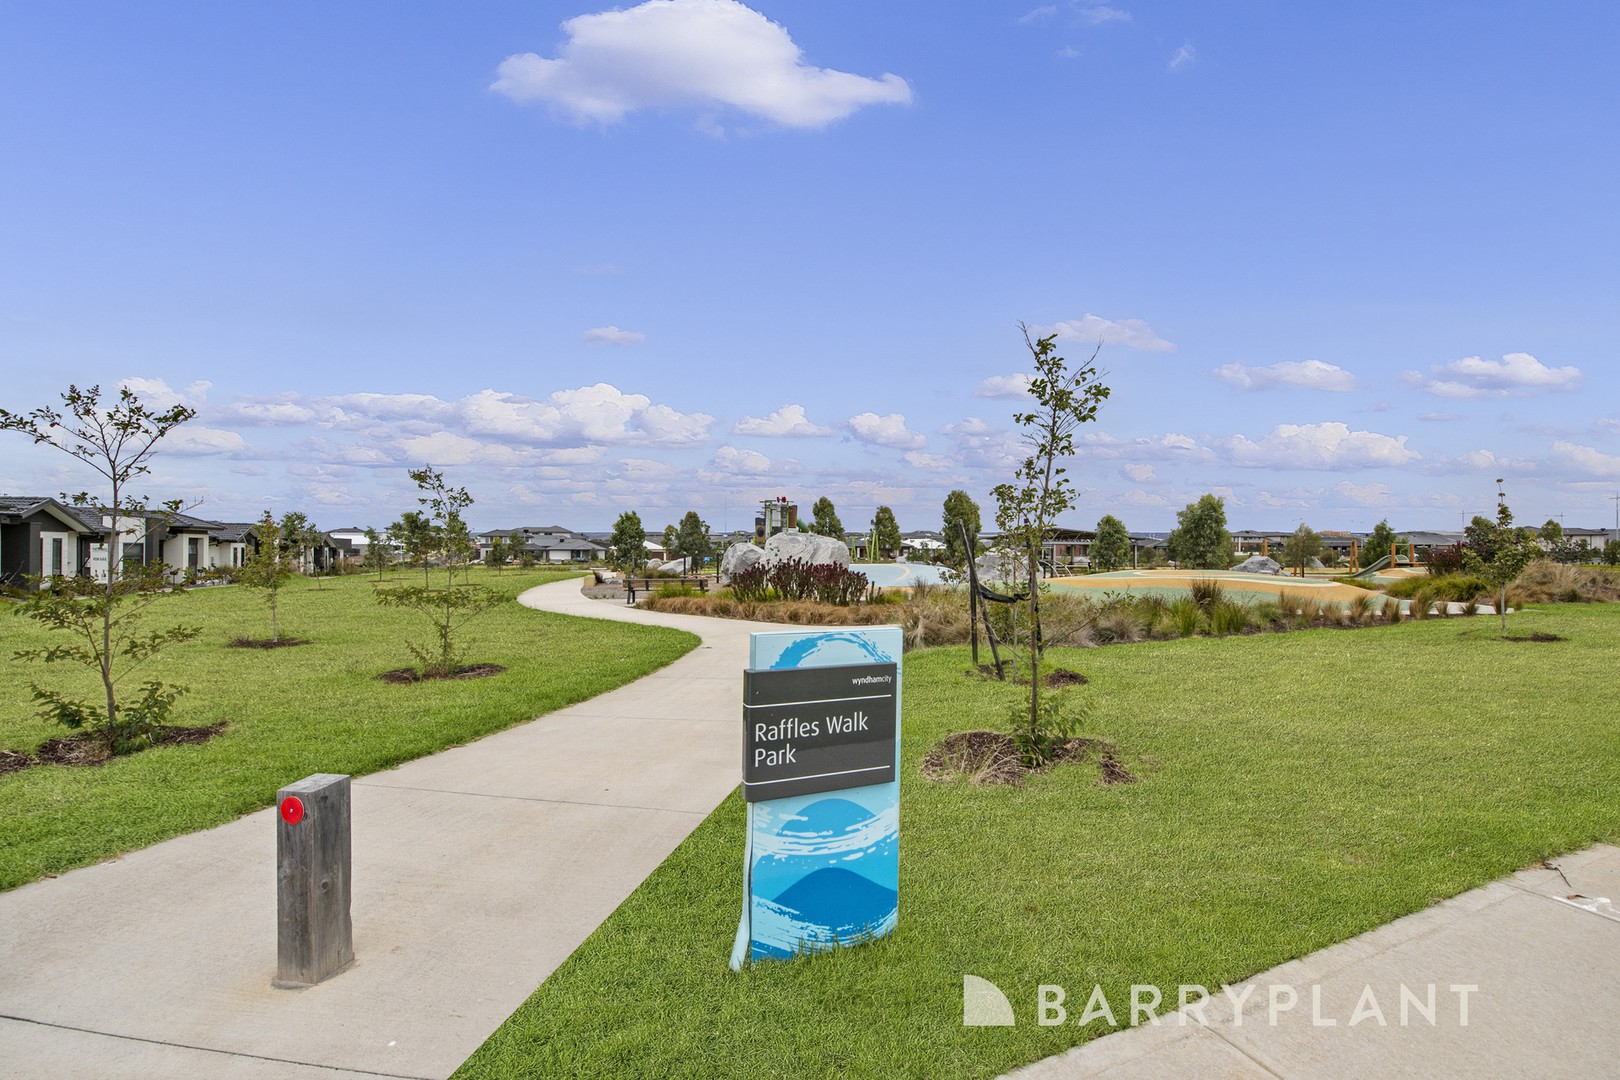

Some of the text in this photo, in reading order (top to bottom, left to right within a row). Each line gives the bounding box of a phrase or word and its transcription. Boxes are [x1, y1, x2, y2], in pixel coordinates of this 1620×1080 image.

[852, 675, 892, 686] wyndhamcity
[755, 711, 869, 742] Raffles Walk
[755, 743, 796, 768] Park
